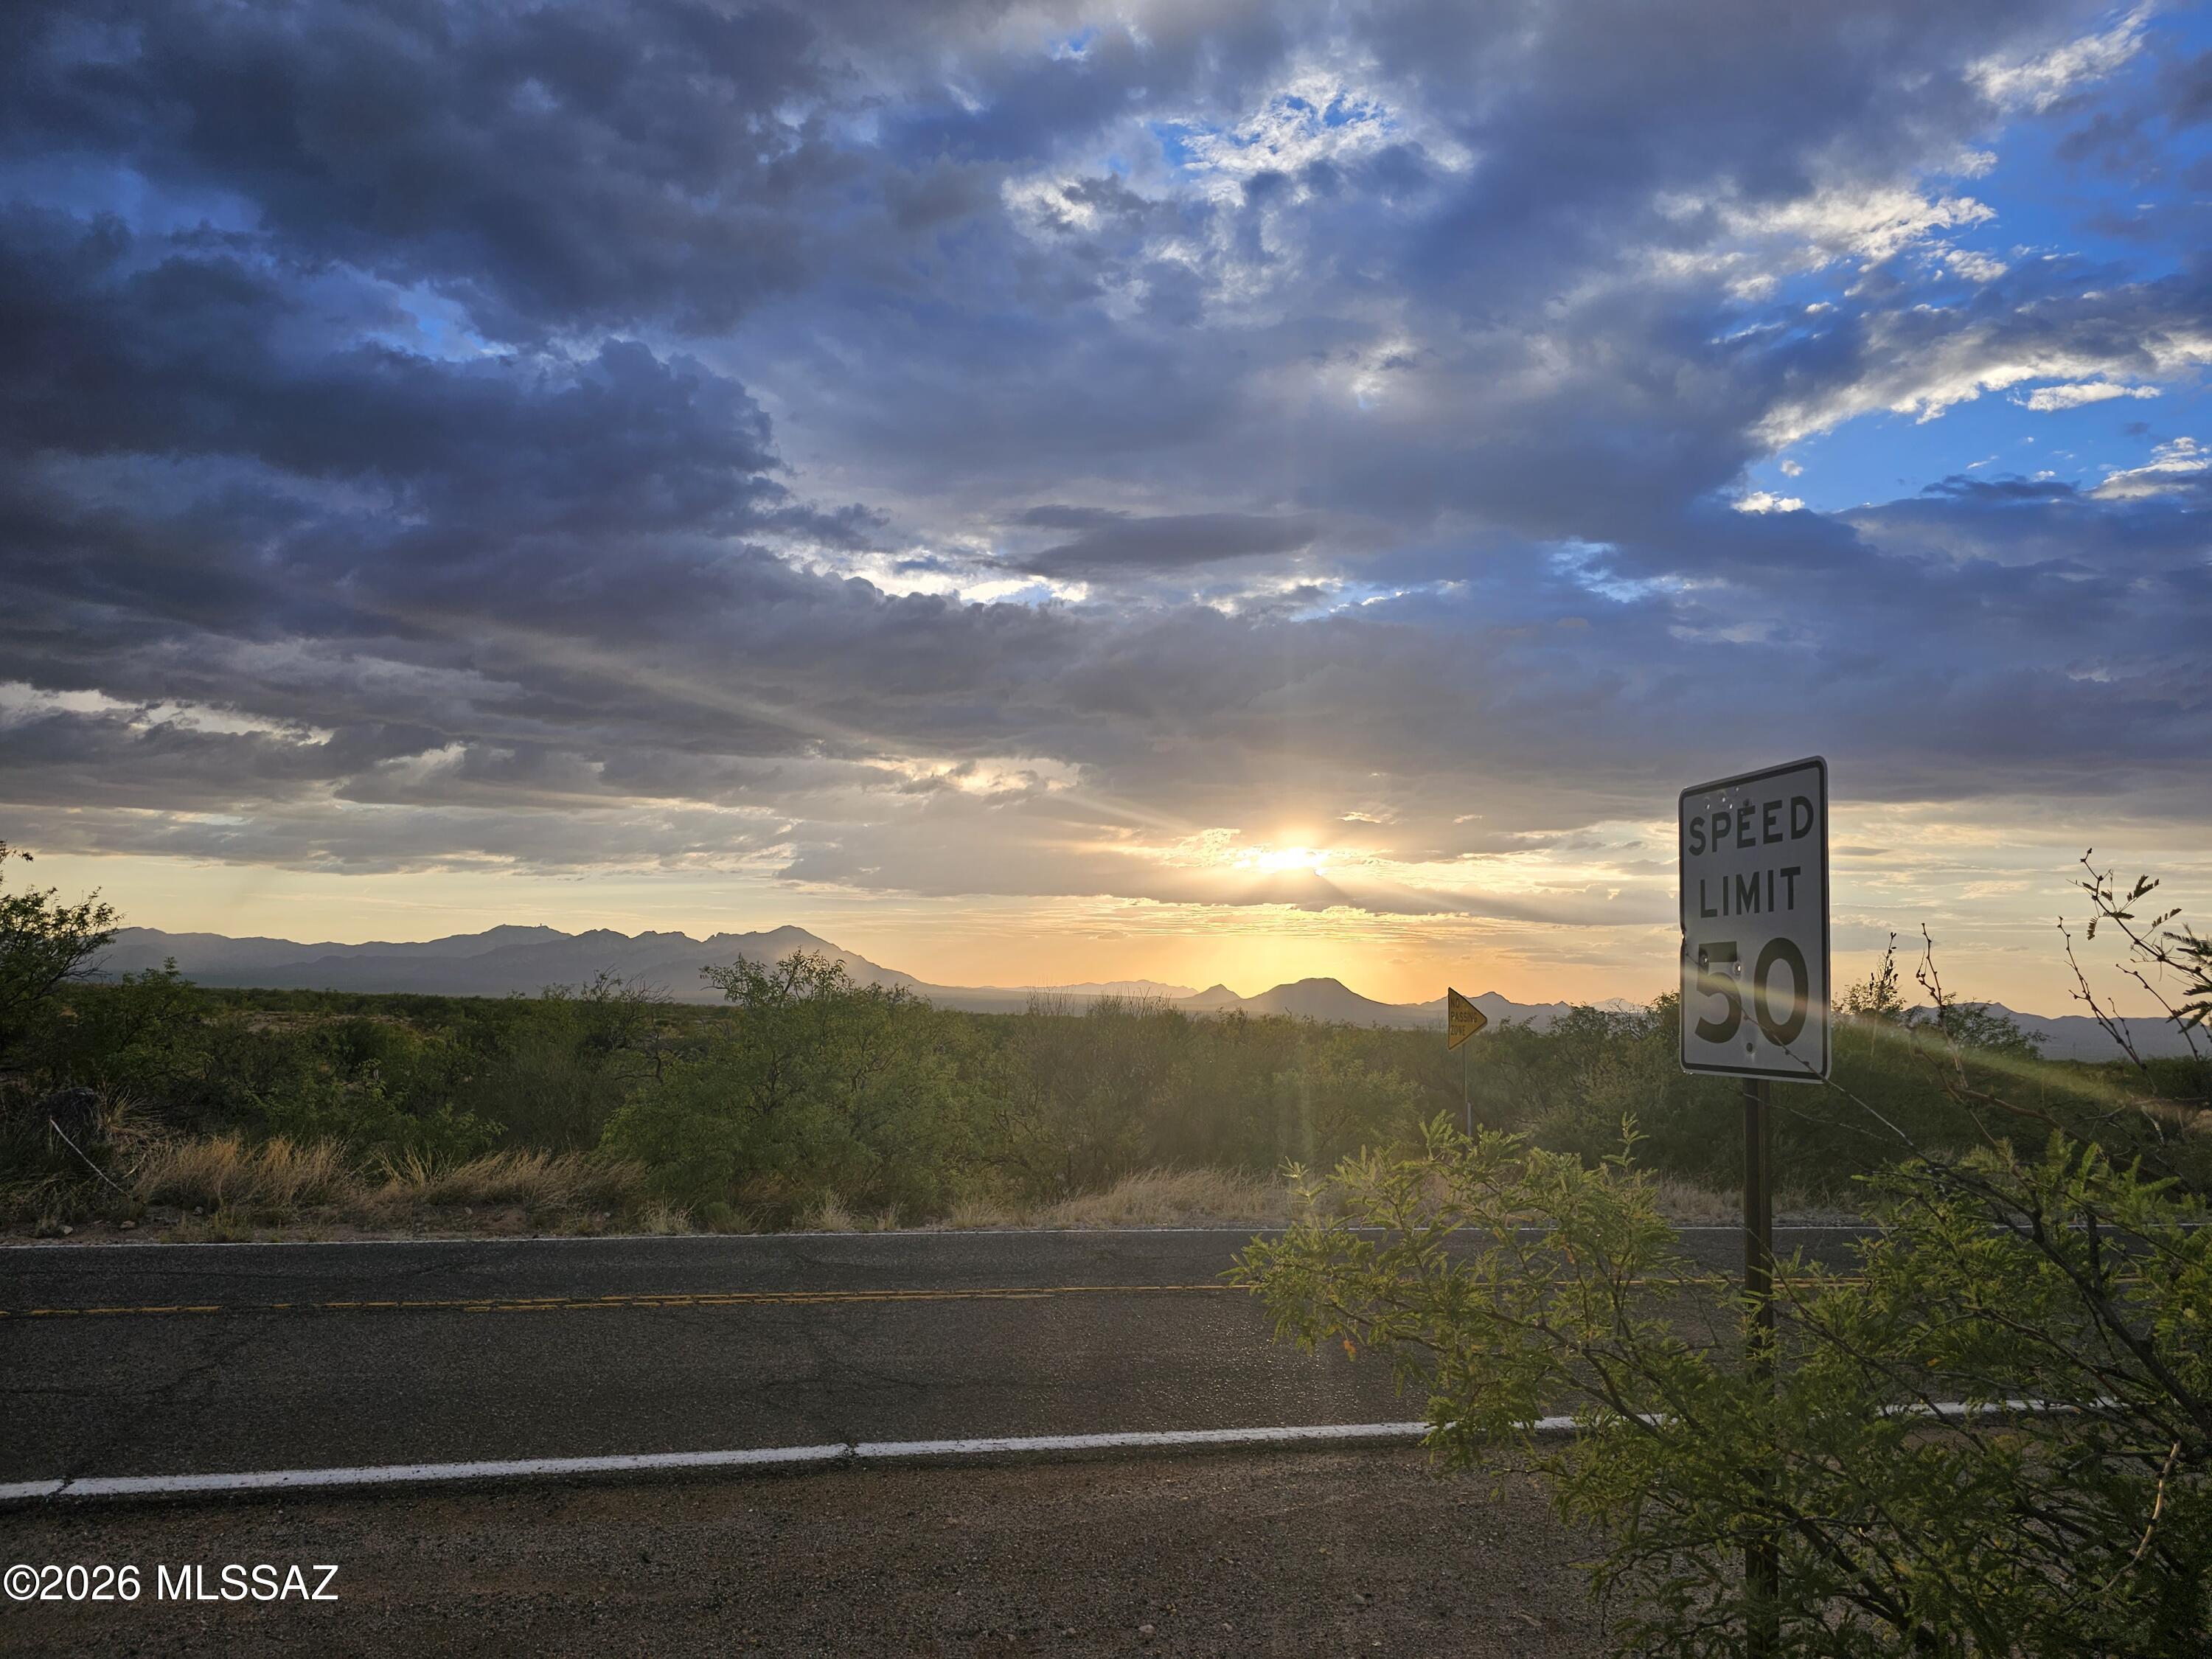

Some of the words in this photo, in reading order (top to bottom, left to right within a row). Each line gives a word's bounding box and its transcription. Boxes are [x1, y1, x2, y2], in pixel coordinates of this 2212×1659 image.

[1688, 796, 1814, 856] SPEED
[1700, 866, 1801, 918] LIMIT
[1451, 998, 1460, 1008] NO
[1695, 937, 1809, 1046] 50
[1450, 1026, 1466, 1036] ZONE
[1451, 1012, 1478, 1023] PASSING
